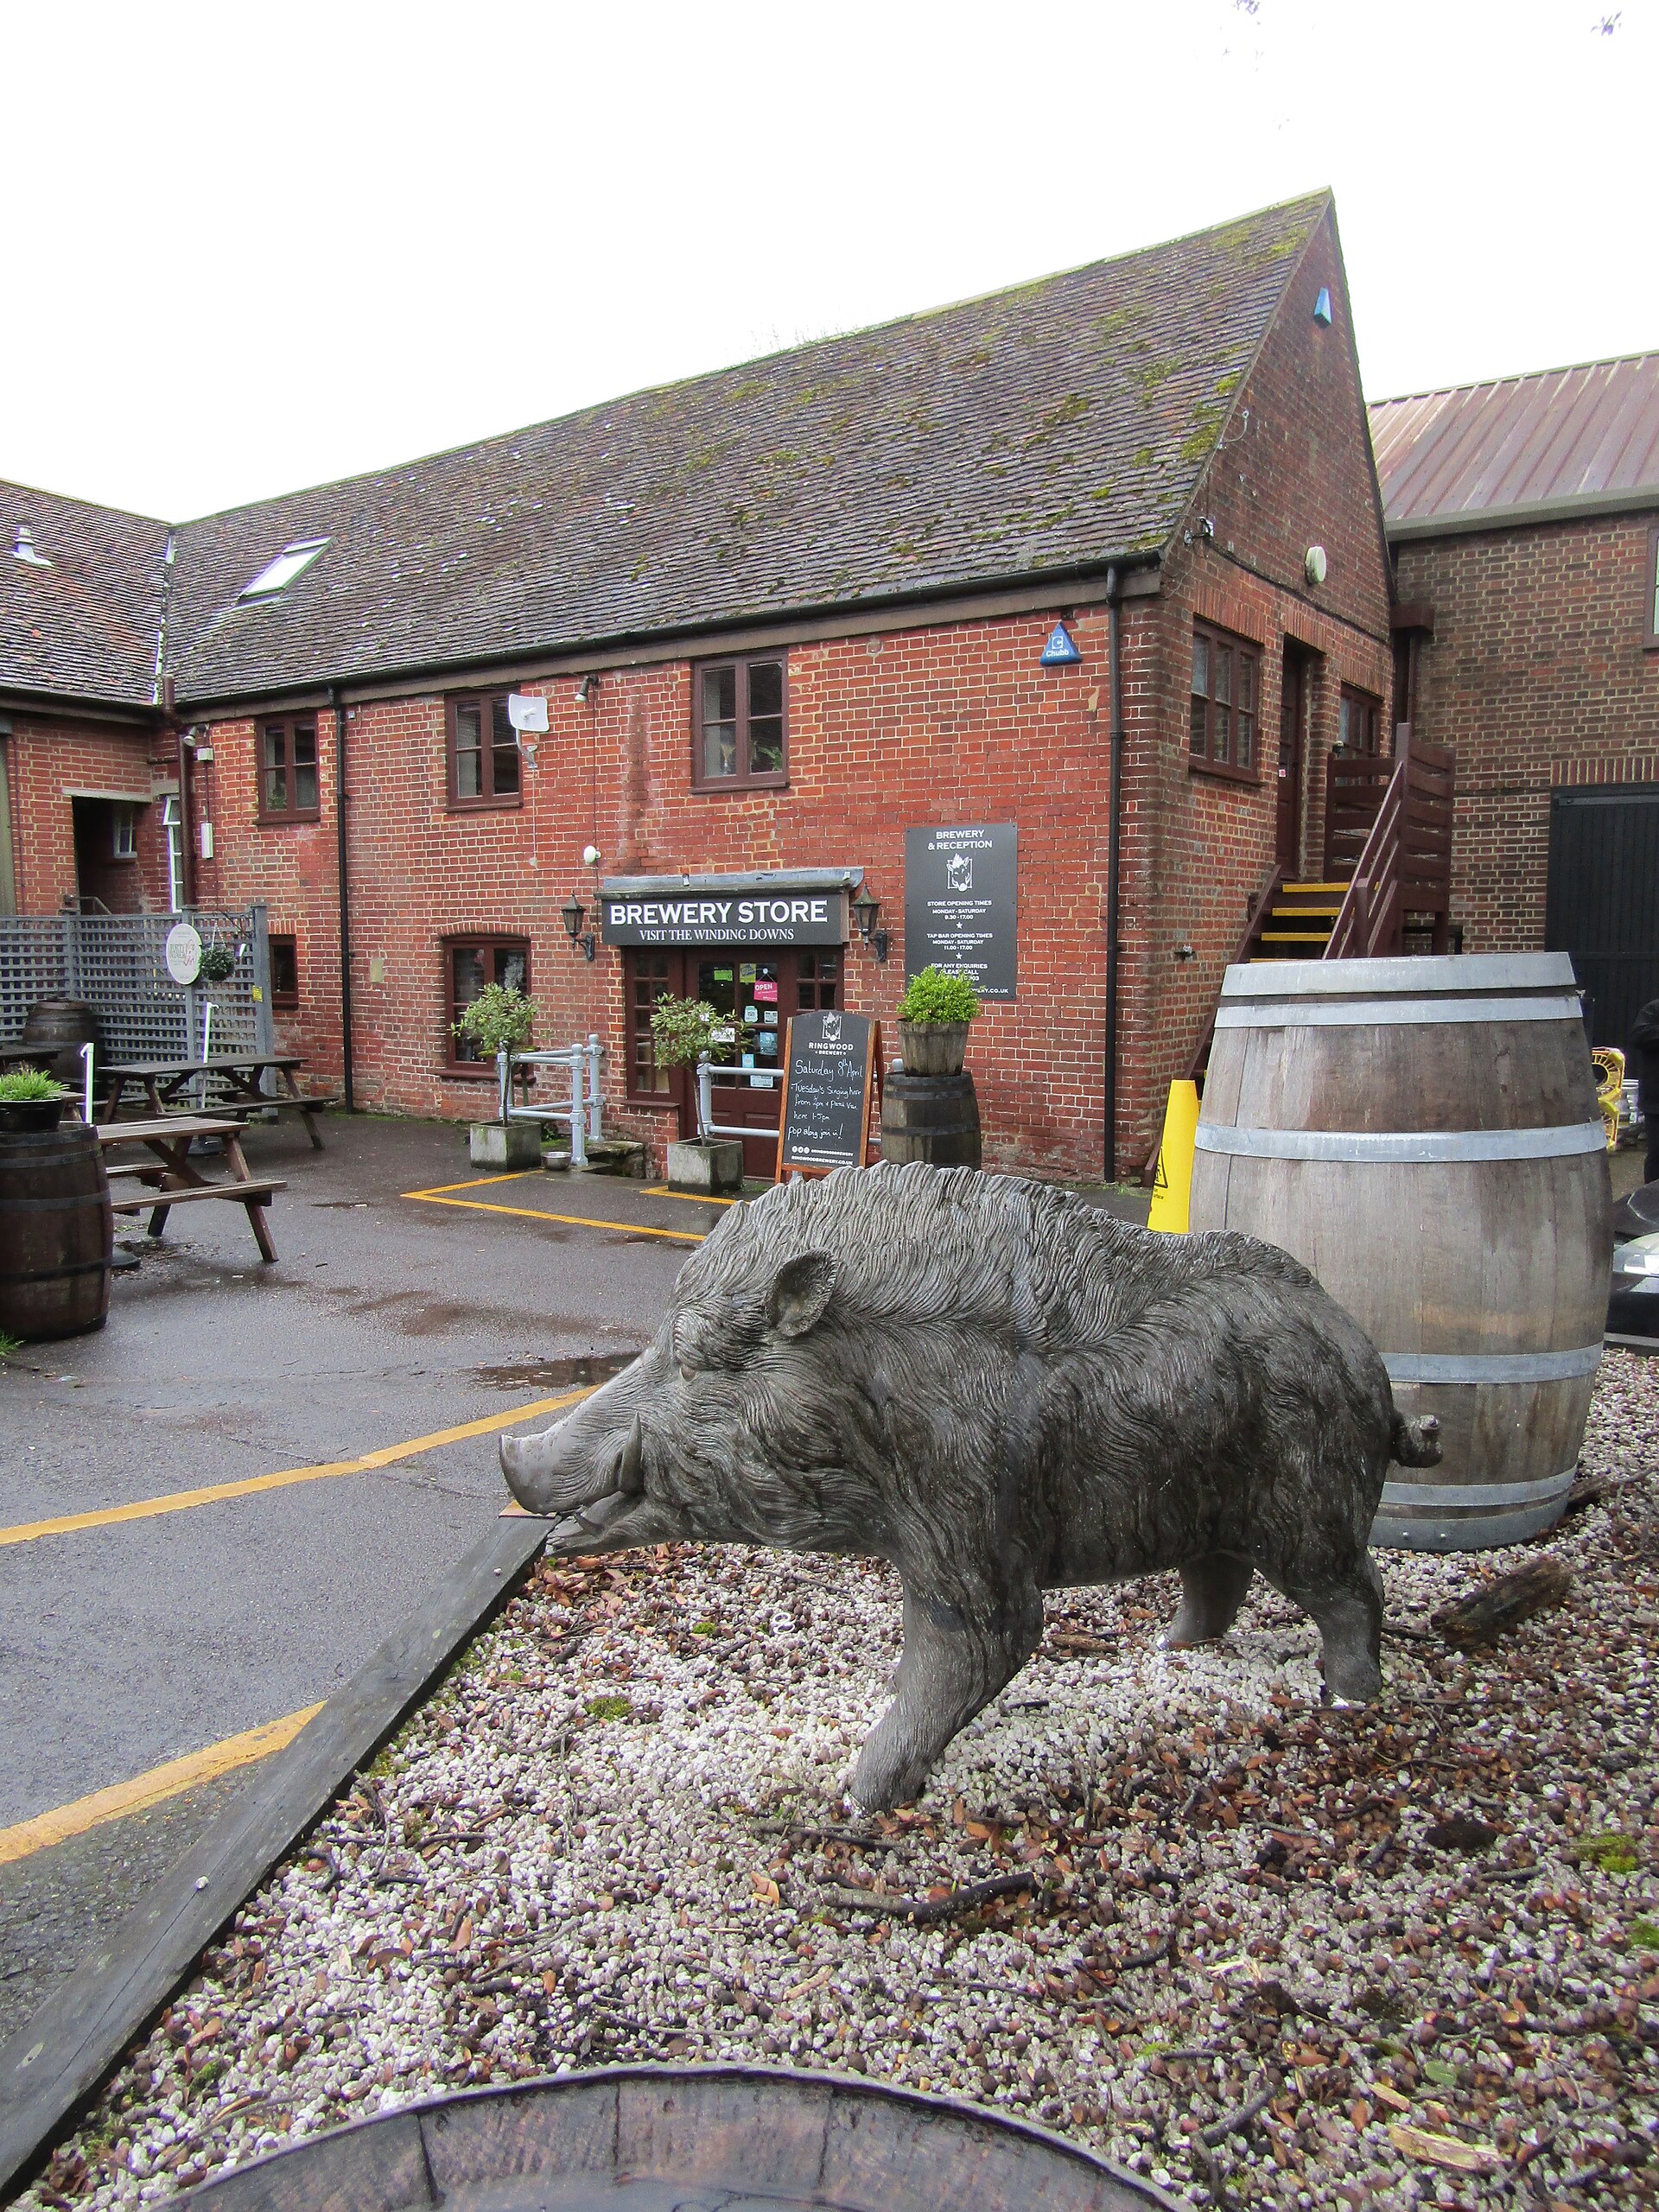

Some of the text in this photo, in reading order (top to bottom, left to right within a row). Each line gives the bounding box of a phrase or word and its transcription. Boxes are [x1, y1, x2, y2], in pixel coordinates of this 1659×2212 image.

[936, 830, 984, 839] BREWERY
[937, 840, 993, 849] RECEPTION
[610, 899, 827, 925] BREWERY STORE
[639, 928, 794, 941] VISIT THE WINDING DOWNS
[795, 1059, 834, 1082] Saturday
[847, 1060, 862, 1080] April
[849, 1086, 861, 1096] here
[795, 1094, 810, 1106] from
[804, 1126, 818, 1139] along
